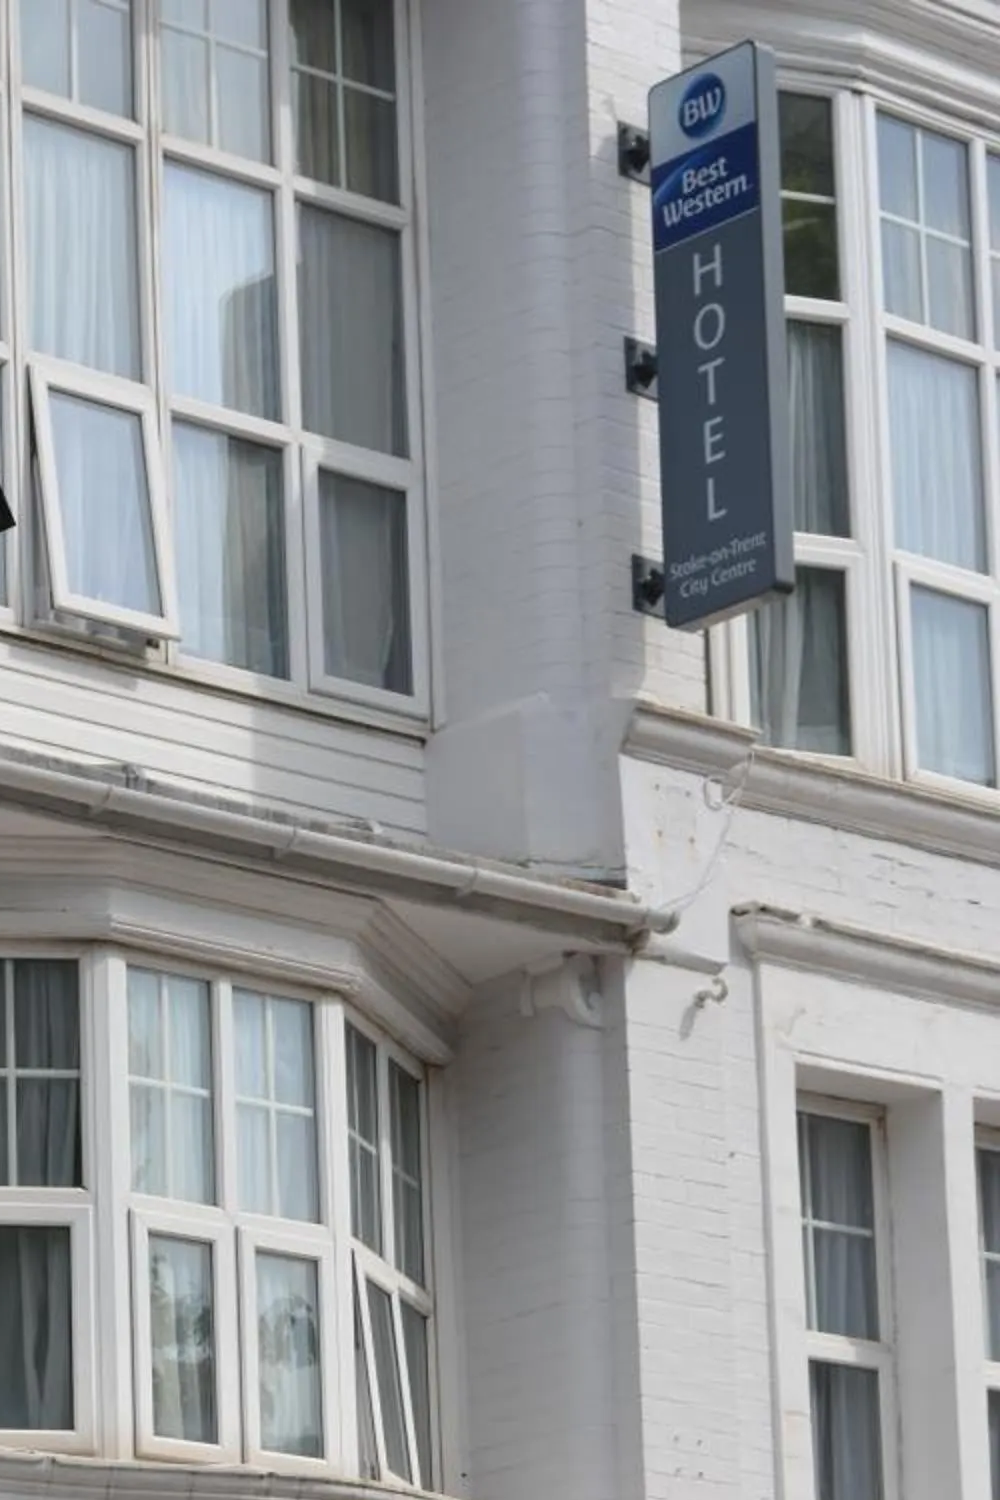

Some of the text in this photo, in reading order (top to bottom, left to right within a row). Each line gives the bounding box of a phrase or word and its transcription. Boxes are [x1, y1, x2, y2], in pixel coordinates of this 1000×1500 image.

[684, 87, 721, 127] BW
[682, 157, 728, 194] Best
[662, 174, 747, 227] Western
[693, 243, 728, 521] HOTEL
[680, 558, 757, 599] City Centre
